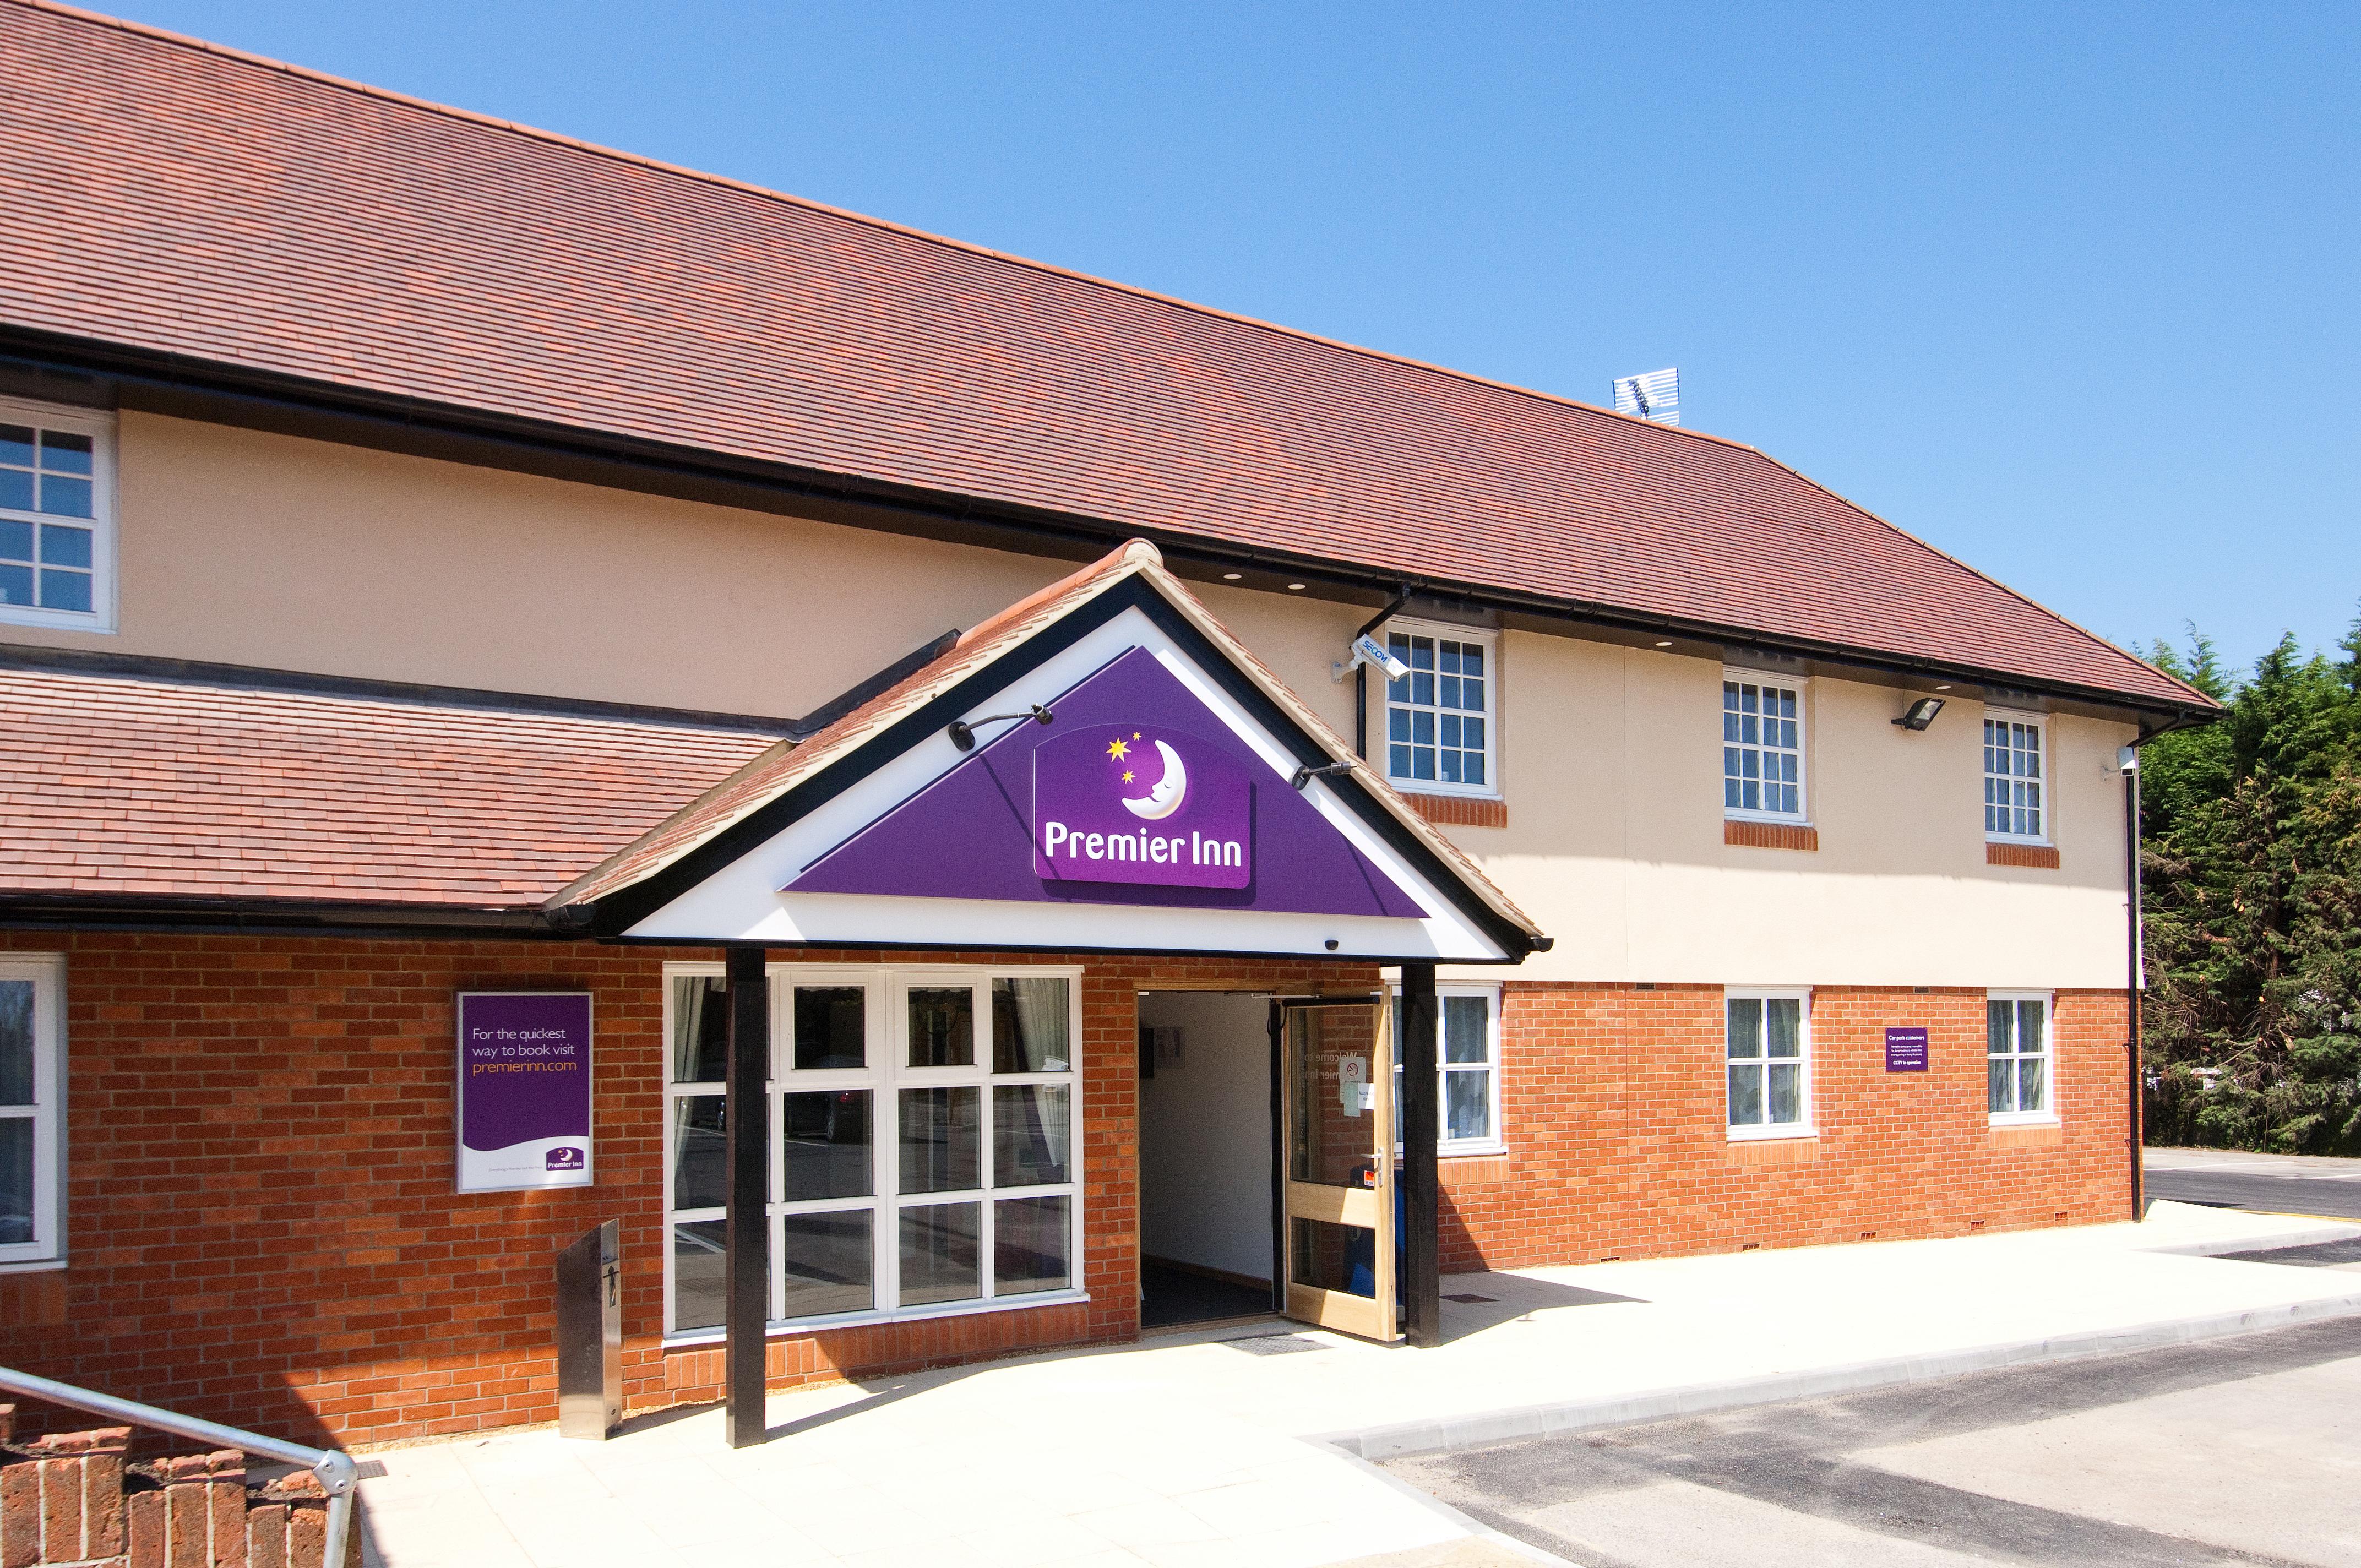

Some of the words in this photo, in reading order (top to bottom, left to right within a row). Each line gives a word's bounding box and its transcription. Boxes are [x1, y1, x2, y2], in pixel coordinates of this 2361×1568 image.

[1362, 640, 1388, 662] SECOM
[1046, 821, 1185, 864] Premier
[1193, 831, 1242, 867] Inn
[472, 1028, 494, 1039] For
[497, 1028, 517, 1039] the
[519, 1027, 567, 1042] quickest
[472, 1048, 498, 1059] way
[501, 1046, 515, 1056] to
[519, 1044, 551, 1056] book
[553, 1043, 575, 1055] visit
[472, 1059, 577, 1077] premierinn.com
